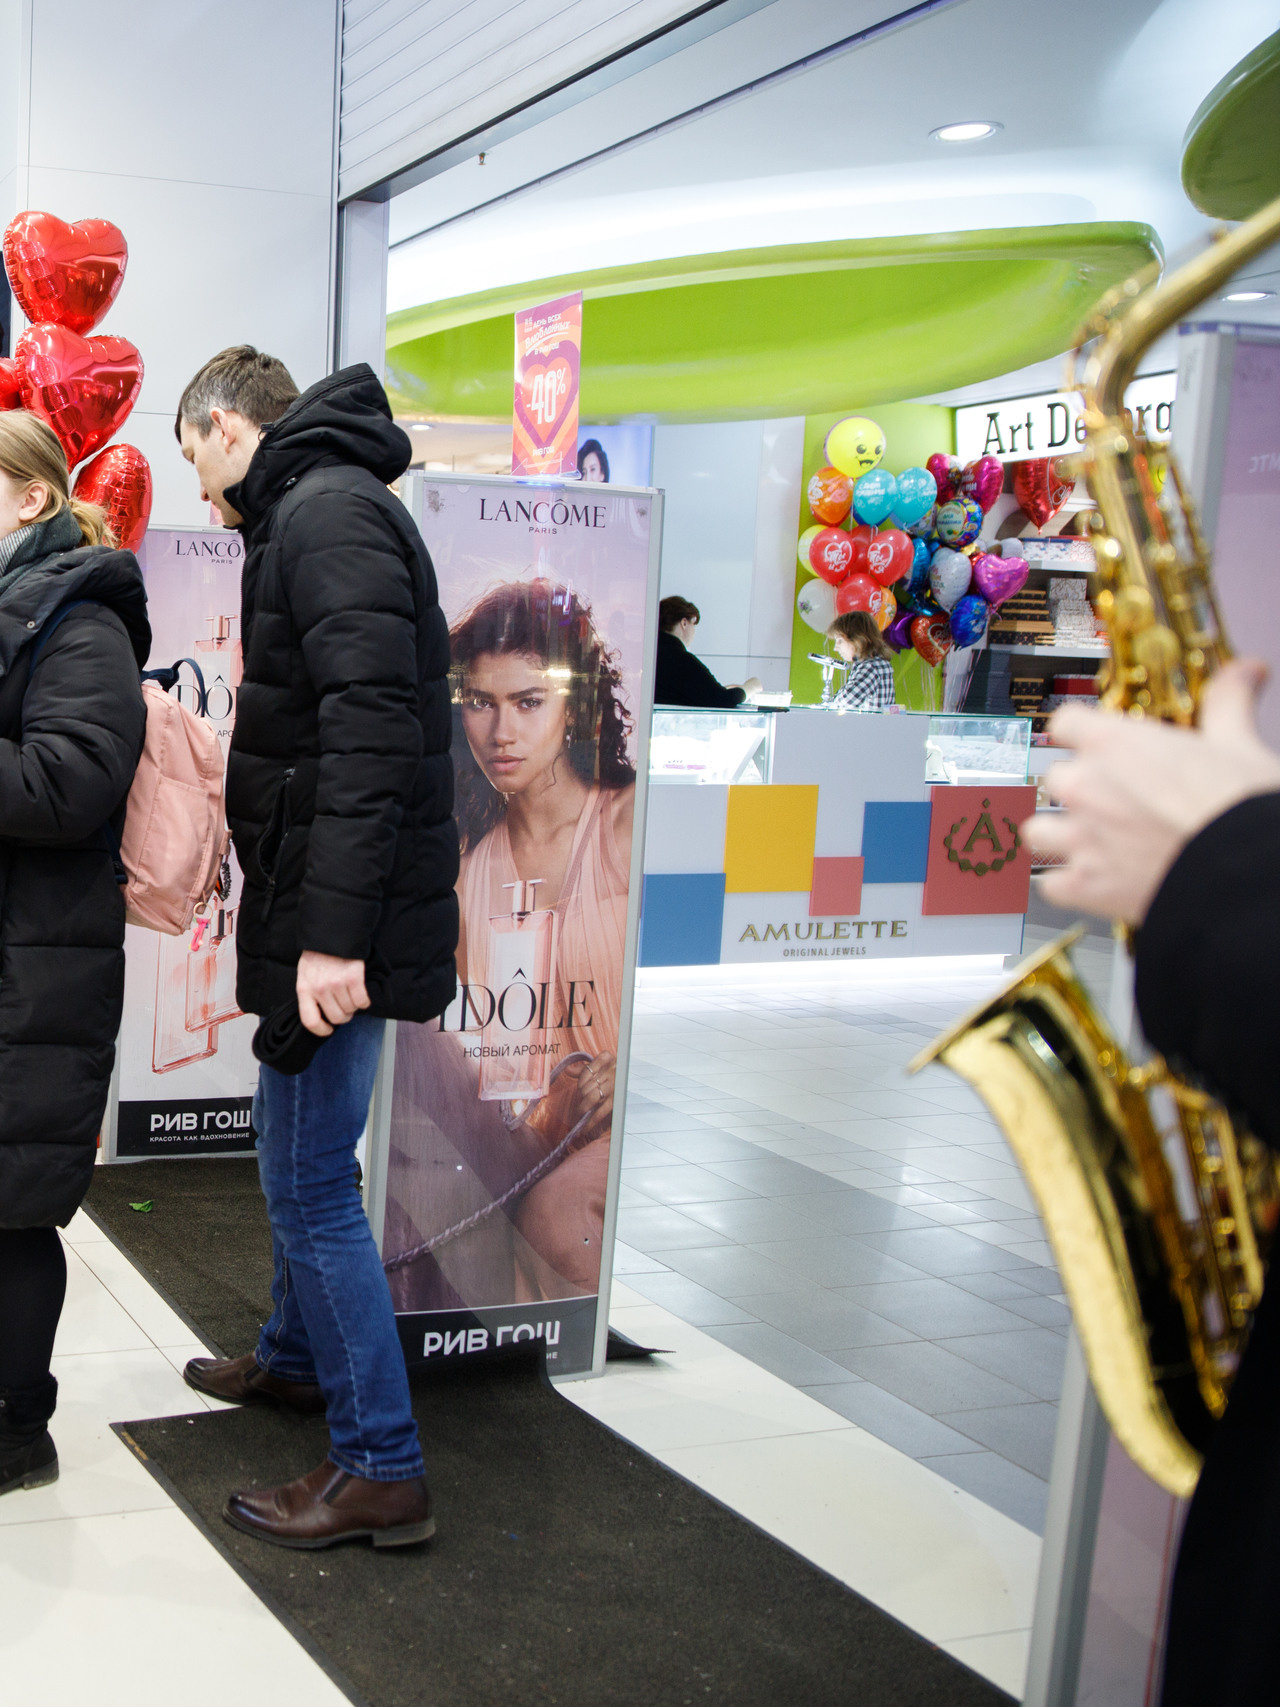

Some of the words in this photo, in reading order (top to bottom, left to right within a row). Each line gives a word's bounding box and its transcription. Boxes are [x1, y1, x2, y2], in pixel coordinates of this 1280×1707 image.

[982, 411, 1035, 456] Art
[479, 498, 606, 528] LANCÔME
[528, 527, 557, 535] PARIS
[176, 539, 243, 558] LANCÔ
[739, 920, 908, 942] AMULETTE
[783, 948, 829, 957] ORIGINAL
[830, 946, 867, 956] JEWELS
[463, 1043, 510, 1058] НОВЫЙ
[513, 1042, 561, 1056] АРОМАТ
[150, 1113, 198, 1132] РИВ
[203, 1110, 251, 1129] ГОШ
[200, 1132, 250, 1140] ВДОХНОВЕНИЕ
[423, 1328, 489, 1357] РИВ
[496, 1320, 561, 1347] ГОШ
